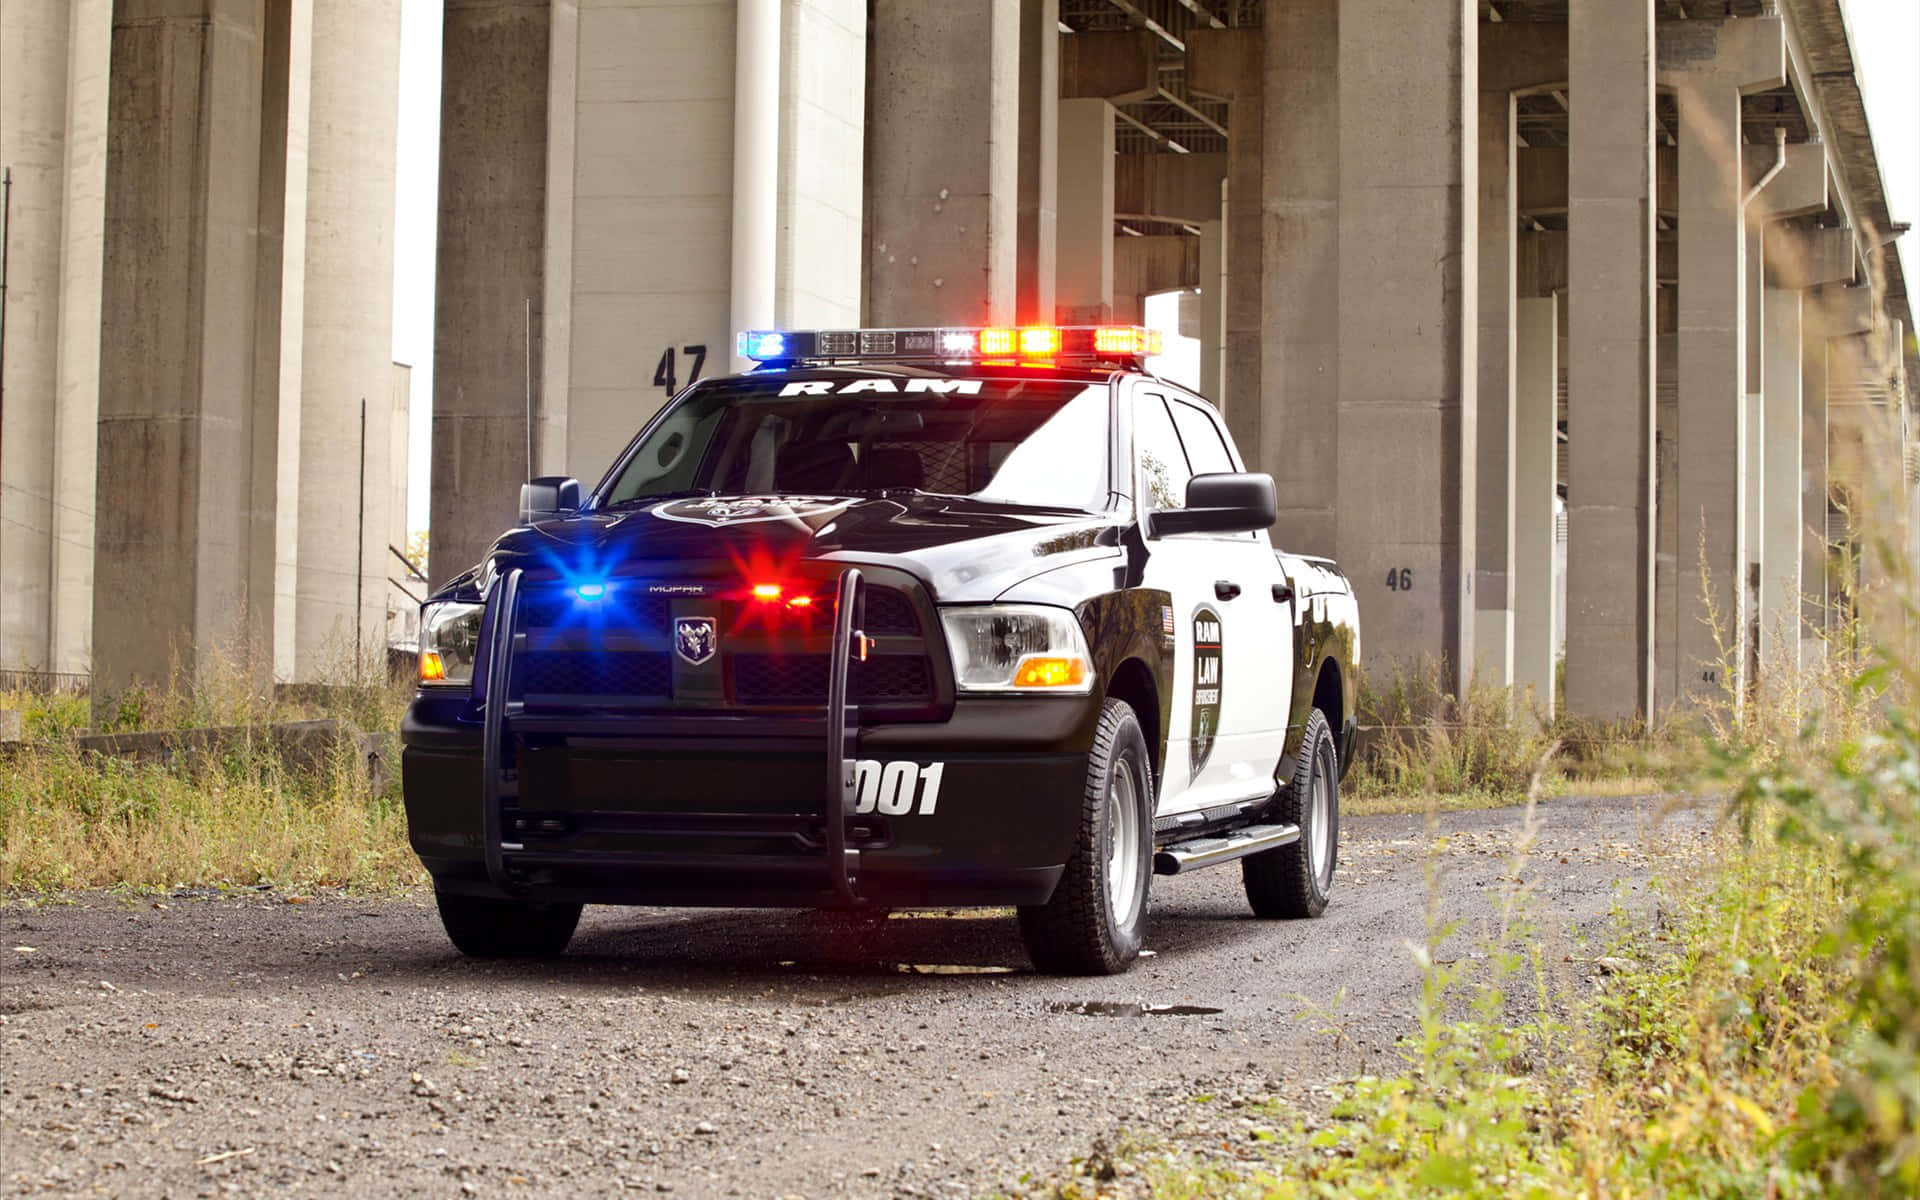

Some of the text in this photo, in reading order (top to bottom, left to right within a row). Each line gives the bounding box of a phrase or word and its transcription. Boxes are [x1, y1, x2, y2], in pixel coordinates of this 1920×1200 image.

[653, 344, 706, 397] 47
[778, 378, 983, 397] RAM
[1385, 567, 1412, 592] 46
[1195, 621, 1220, 642] RAM
[1198, 656, 1219, 684] LAW
[855, 759, 944, 815] 001
